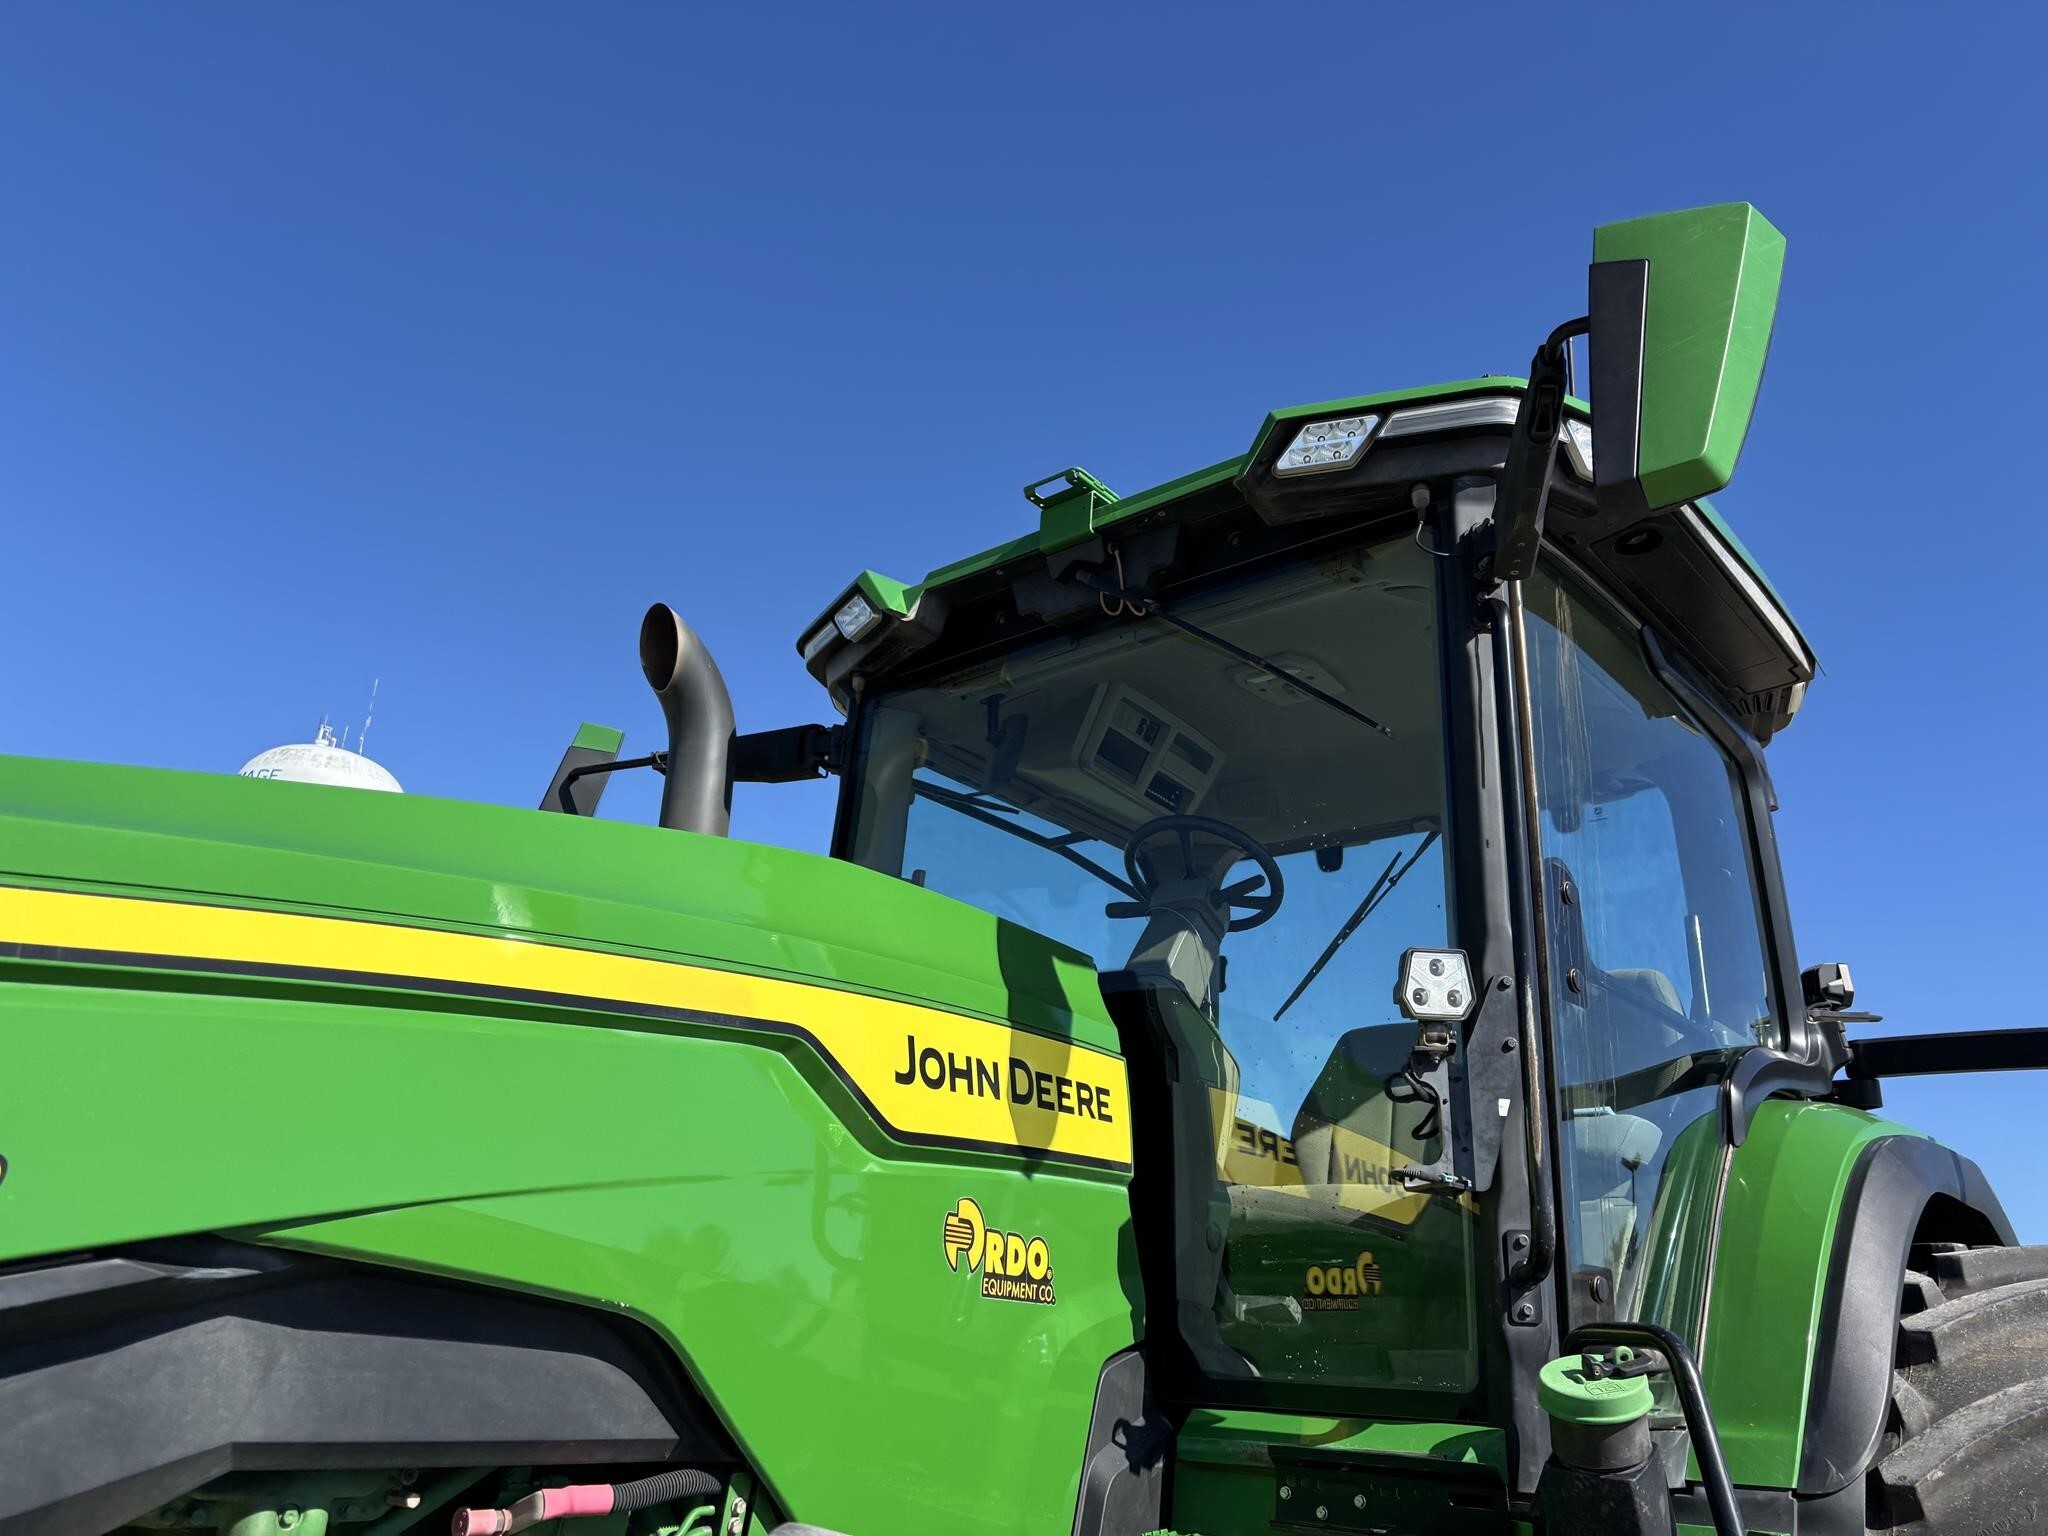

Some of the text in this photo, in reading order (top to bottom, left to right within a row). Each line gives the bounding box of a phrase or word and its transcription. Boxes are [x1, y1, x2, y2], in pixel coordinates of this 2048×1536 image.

[239, 768, 283, 779] AGE
[895, 1034, 1113, 1124] JOHN DEERE
[982, 1277, 1056, 1303] EQUIPMENT CO.
